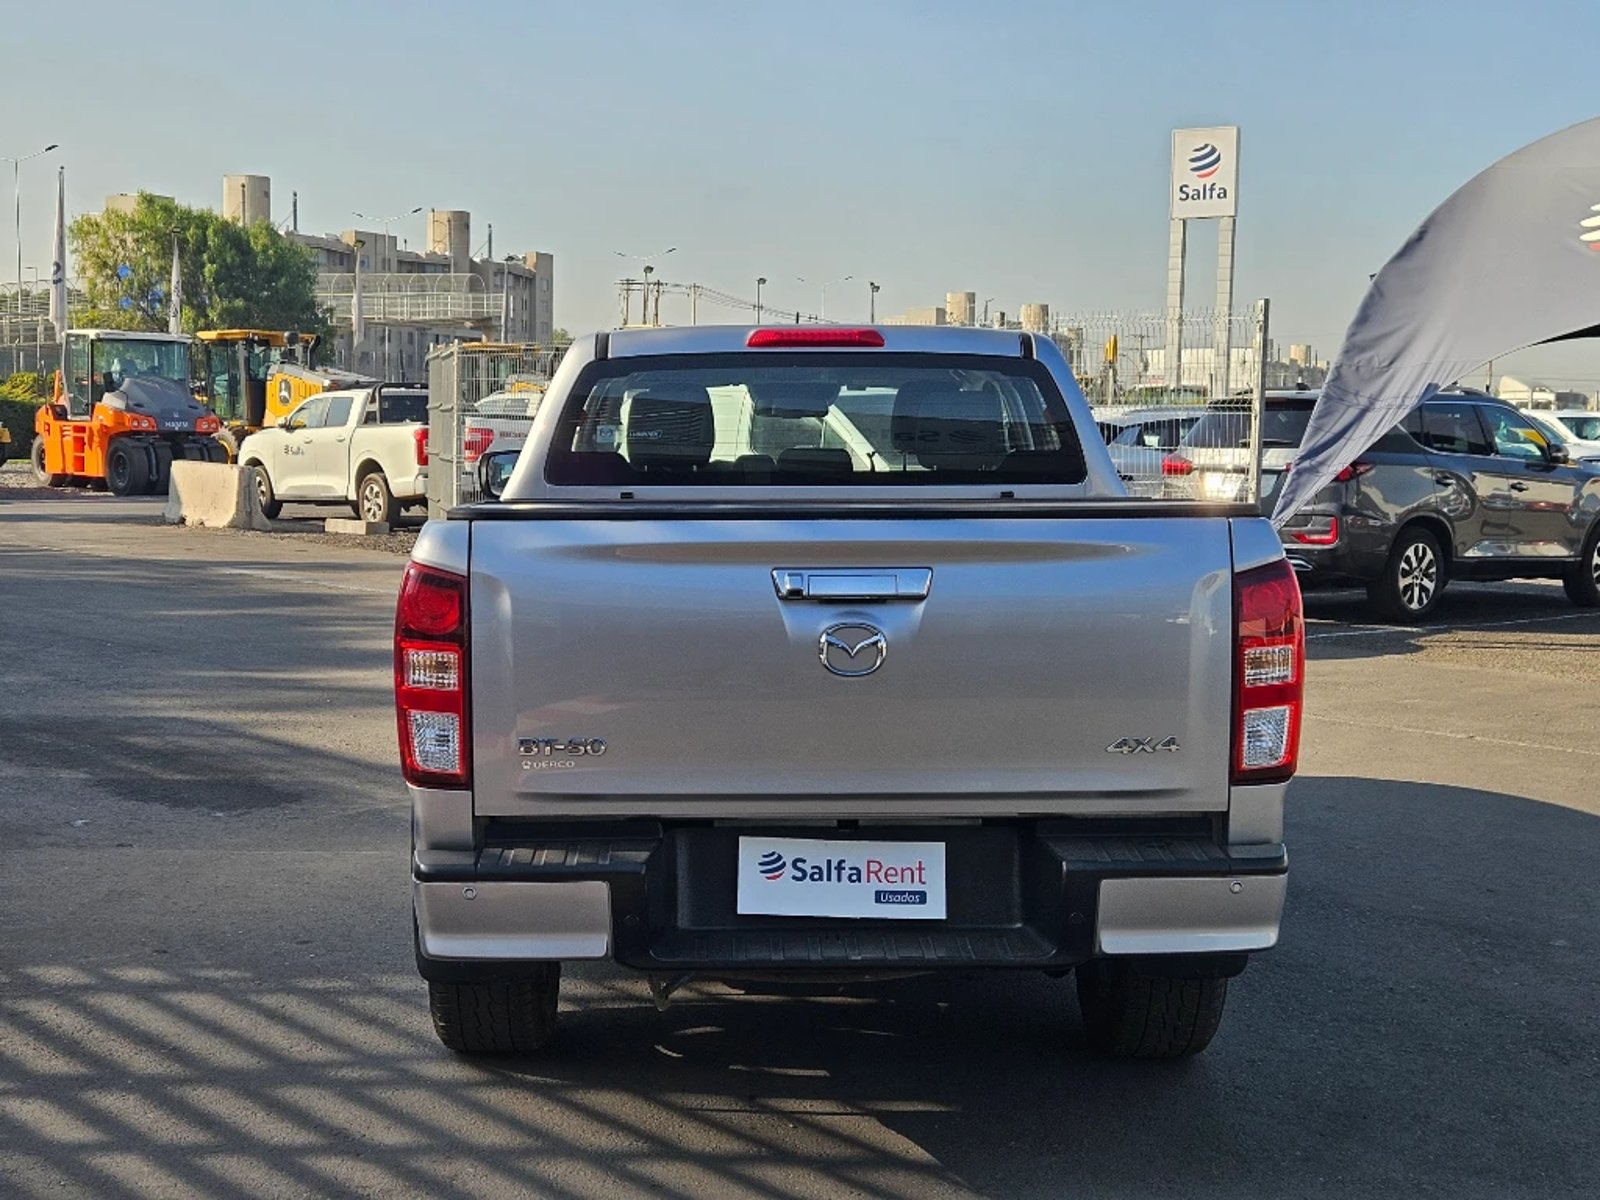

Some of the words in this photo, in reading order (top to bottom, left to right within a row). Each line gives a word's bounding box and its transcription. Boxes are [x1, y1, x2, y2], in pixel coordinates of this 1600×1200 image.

[1178, 182, 1227, 201] Salfa
[518, 737, 607, 756] BT-50
[880, 892, 920, 903] Usados
